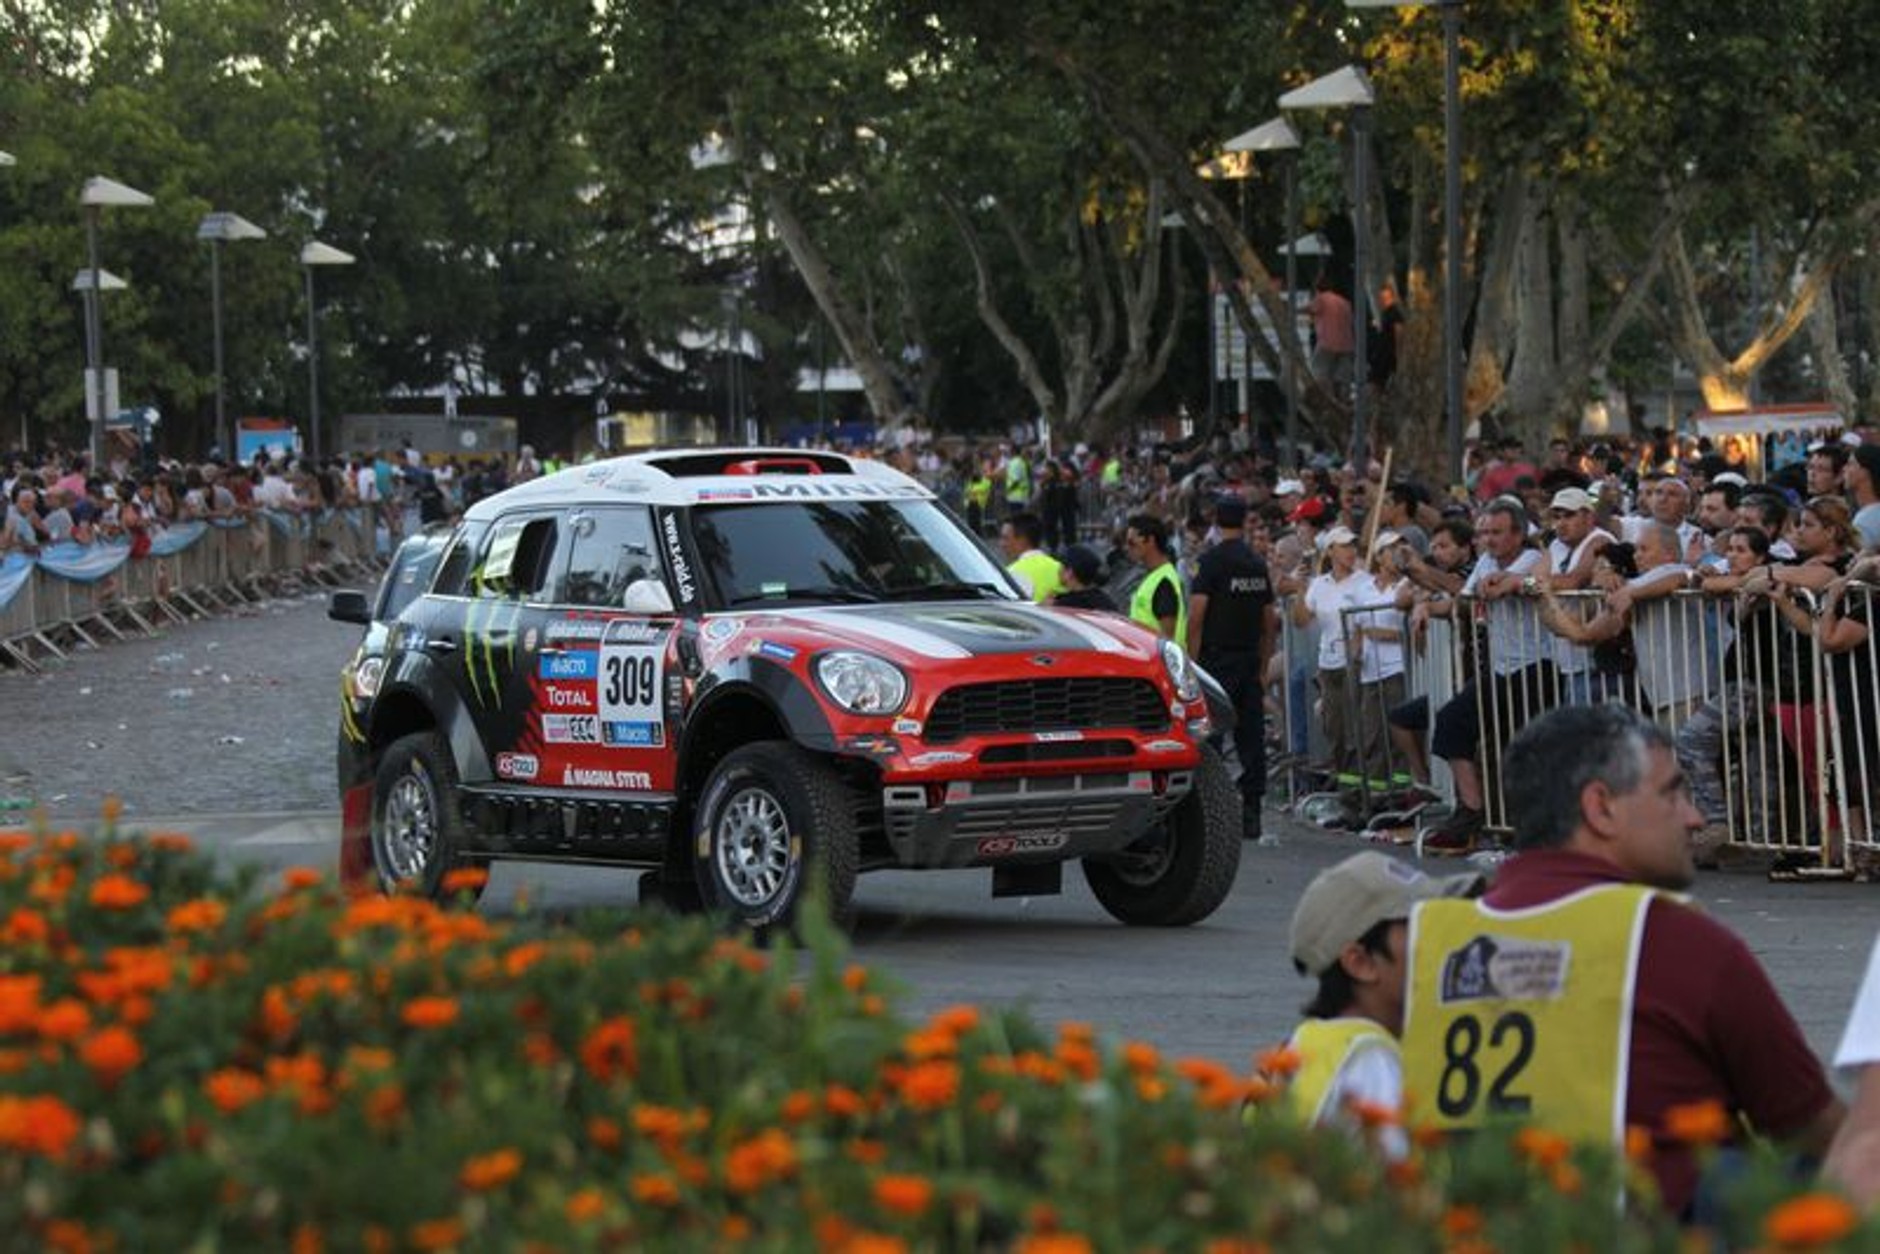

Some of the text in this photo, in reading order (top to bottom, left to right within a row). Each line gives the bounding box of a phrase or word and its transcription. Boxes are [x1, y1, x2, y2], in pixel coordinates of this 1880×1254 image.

[546, 686, 592, 706] TOTAL
[606, 655, 655, 706] 309
[617, 770, 652, 790] STEYR
[1437, 1011, 1536, 1118] 82
